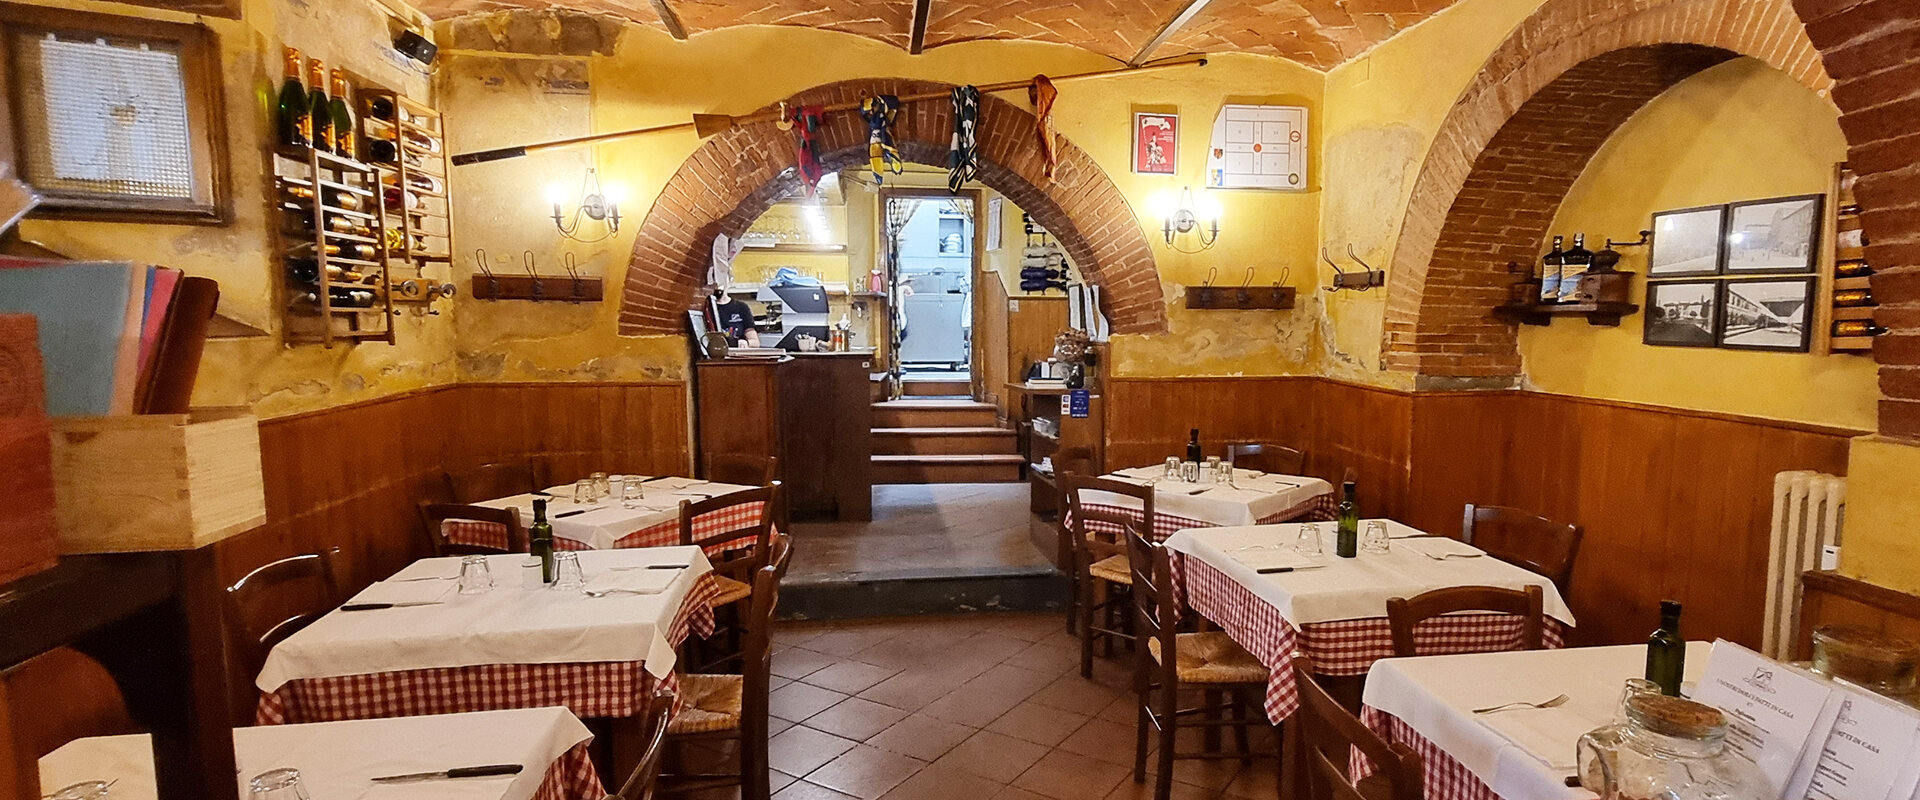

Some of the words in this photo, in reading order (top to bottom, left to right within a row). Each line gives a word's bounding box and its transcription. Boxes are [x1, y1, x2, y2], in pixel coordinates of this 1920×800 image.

[1753, 696, 1771, 708] FATTI
[1777, 707, 1794, 719] CASA
[1851, 736, 1861, 745] IN
[1861, 741, 1881, 754] CASA
